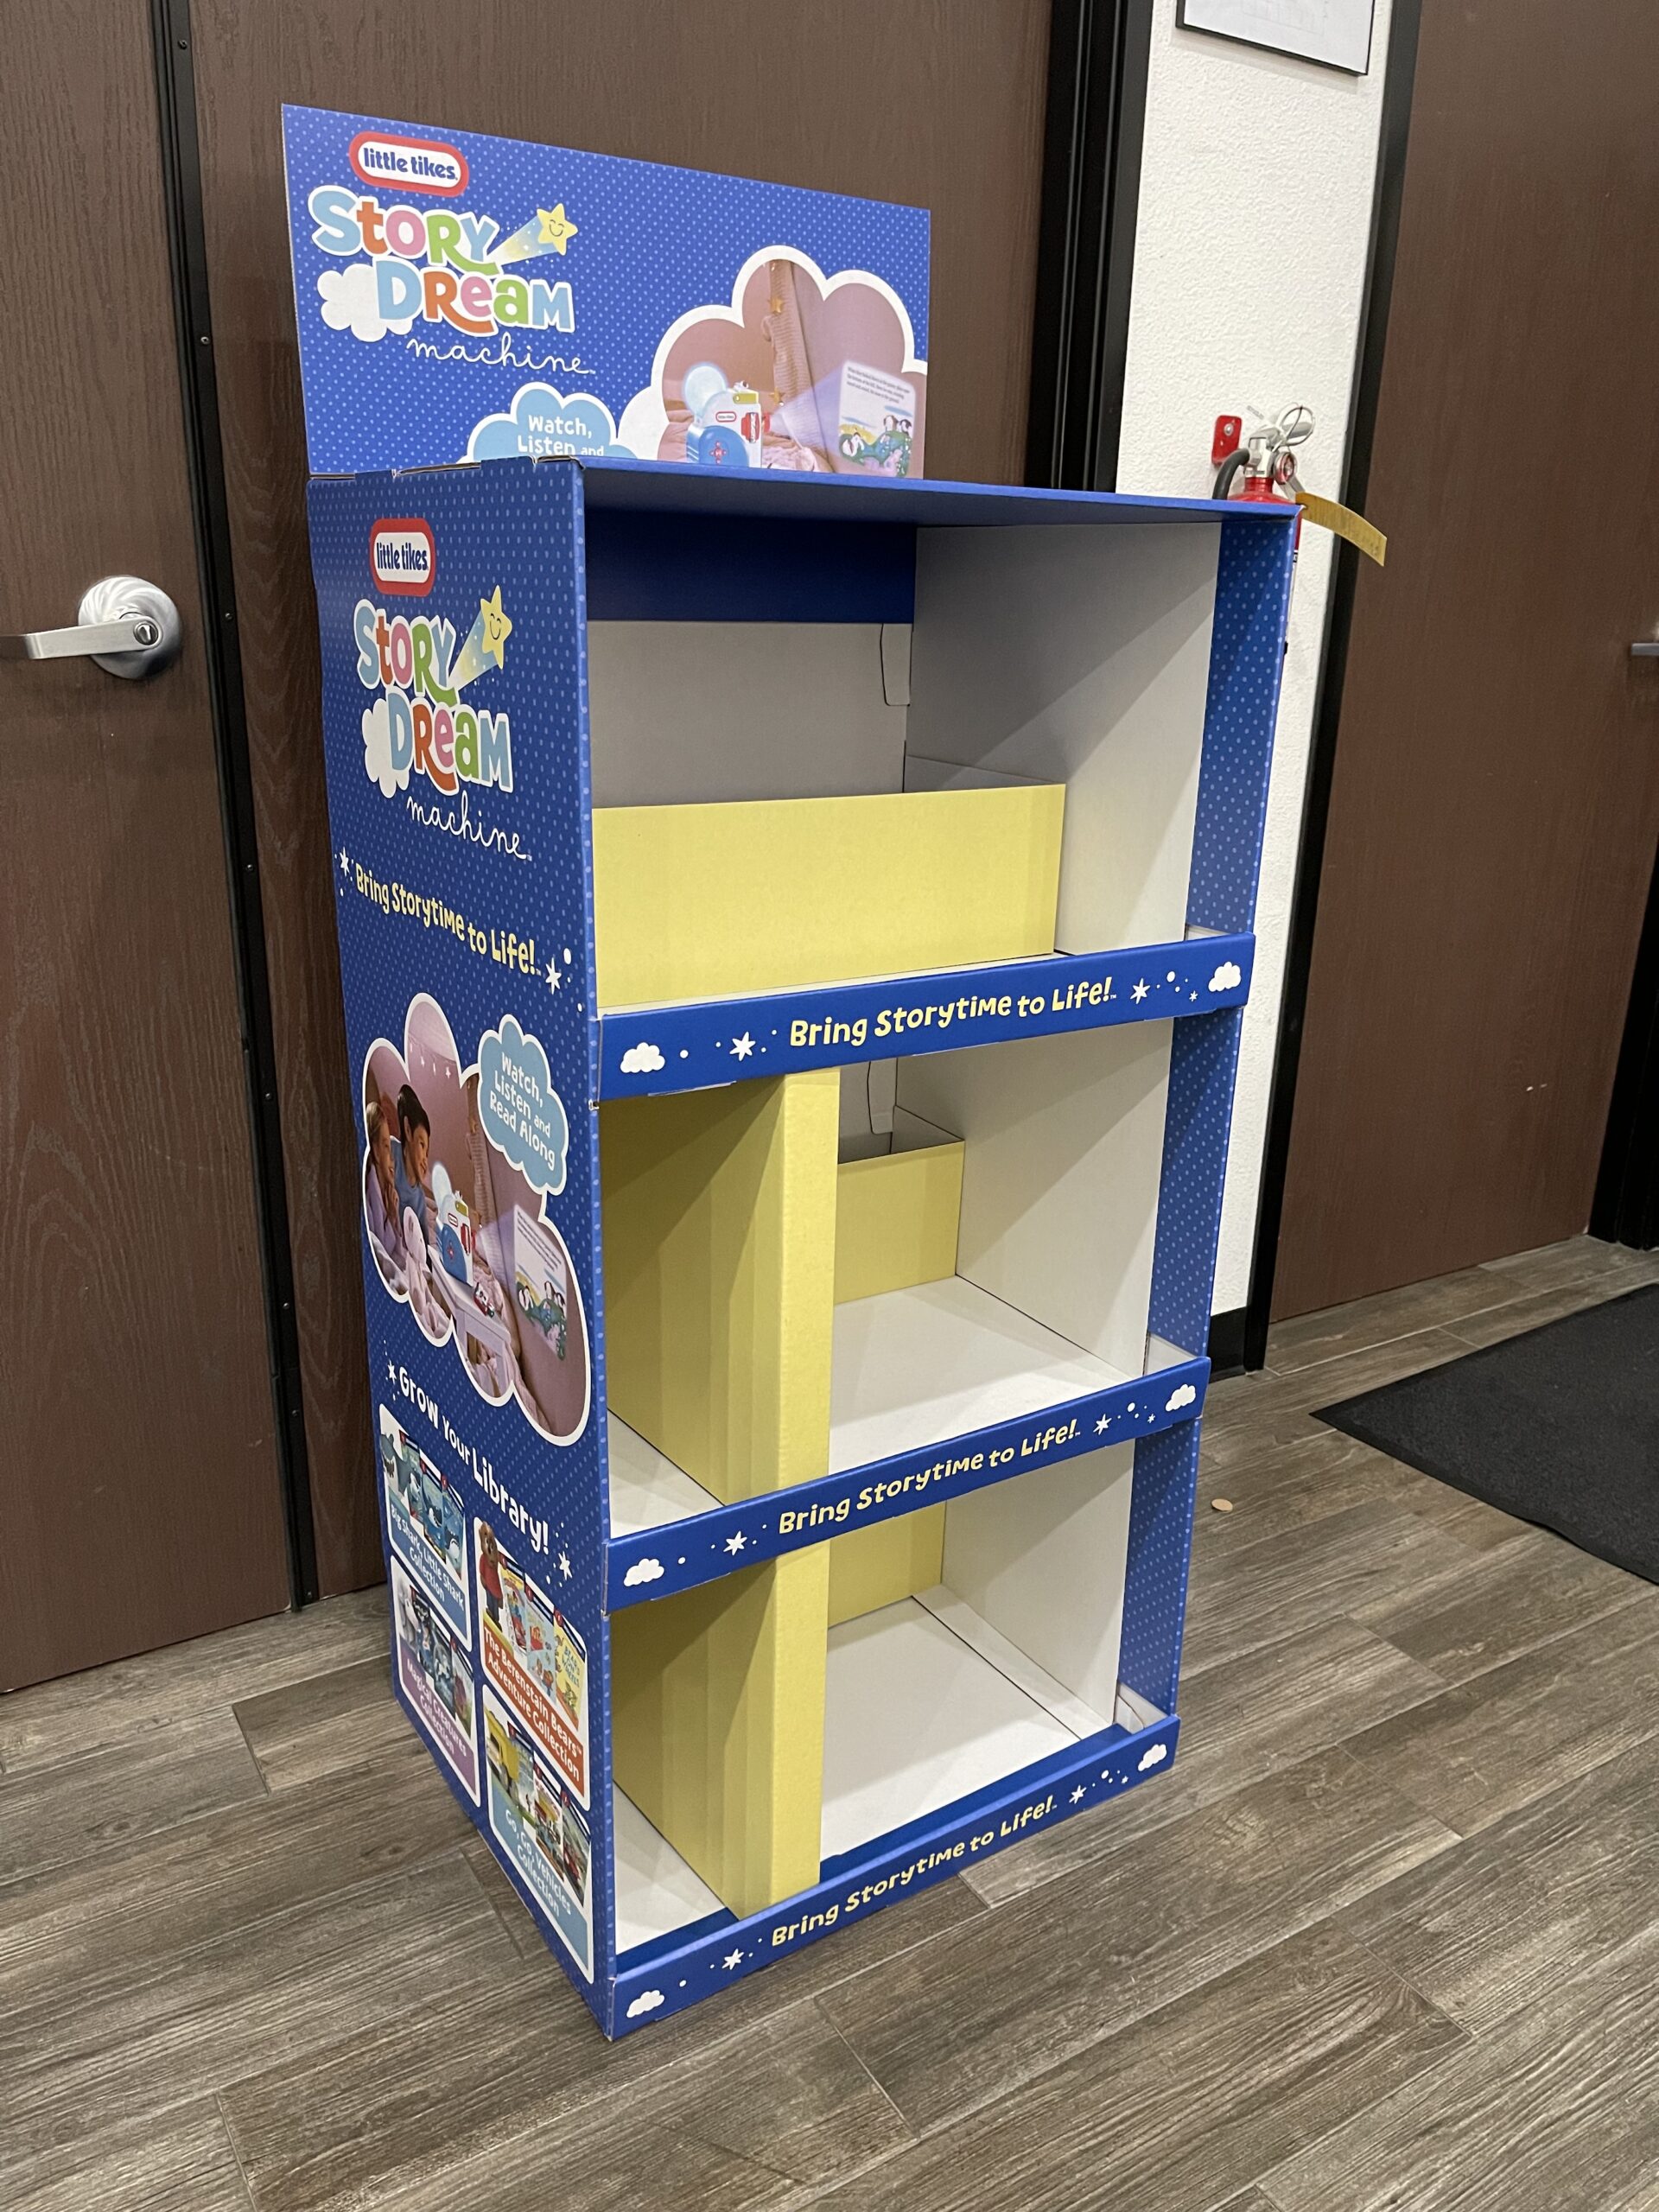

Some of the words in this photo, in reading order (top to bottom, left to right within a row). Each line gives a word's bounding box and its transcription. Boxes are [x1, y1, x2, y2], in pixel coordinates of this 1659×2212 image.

[363, 148, 408, 173] little
[411, 154, 456, 181] tikes
[407, 332, 593, 374] machine
[518, 435, 575, 455] Listen
[581, 445, 604, 456] and
[528, 415, 592, 439] Watch,
[377, 543, 400, 569] little
[401, 546, 429, 570] tikes
[407, 790, 530, 859] machine
[356, 863, 390, 914] Bring
[467, 922, 486, 955] to
[790, 1016, 867, 1046] Bring
[1017, 995, 1044, 1017] to
[494, 1071, 531, 1120] Listen
[534, 1115, 550, 1139] and
[502, 1052, 543, 1108] Watch,
[489, 1090, 516, 1133] Read
[519, 1121, 556, 1172] Along
[473, 1447, 549, 1554] Library!
[779, 1498, 850, 1535] Bring
[988, 1447, 1014, 1468] to
[410, 1548, 445, 1602] Collection
[442, 1574, 464, 1611] Shark
[484, 1626, 499, 1653] The
[501, 1649, 549, 1720] Berenstain
[488, 1655, 531, 1718] Adventure
[533, 1710, 580, 1782] Collection
[518, 1844, 560, 1917] Collection
[535, 1852, 571, 1916] Vehicles
[772, 1904, 840, 1948] Bring
[969, 1831, 994, 1853] to
